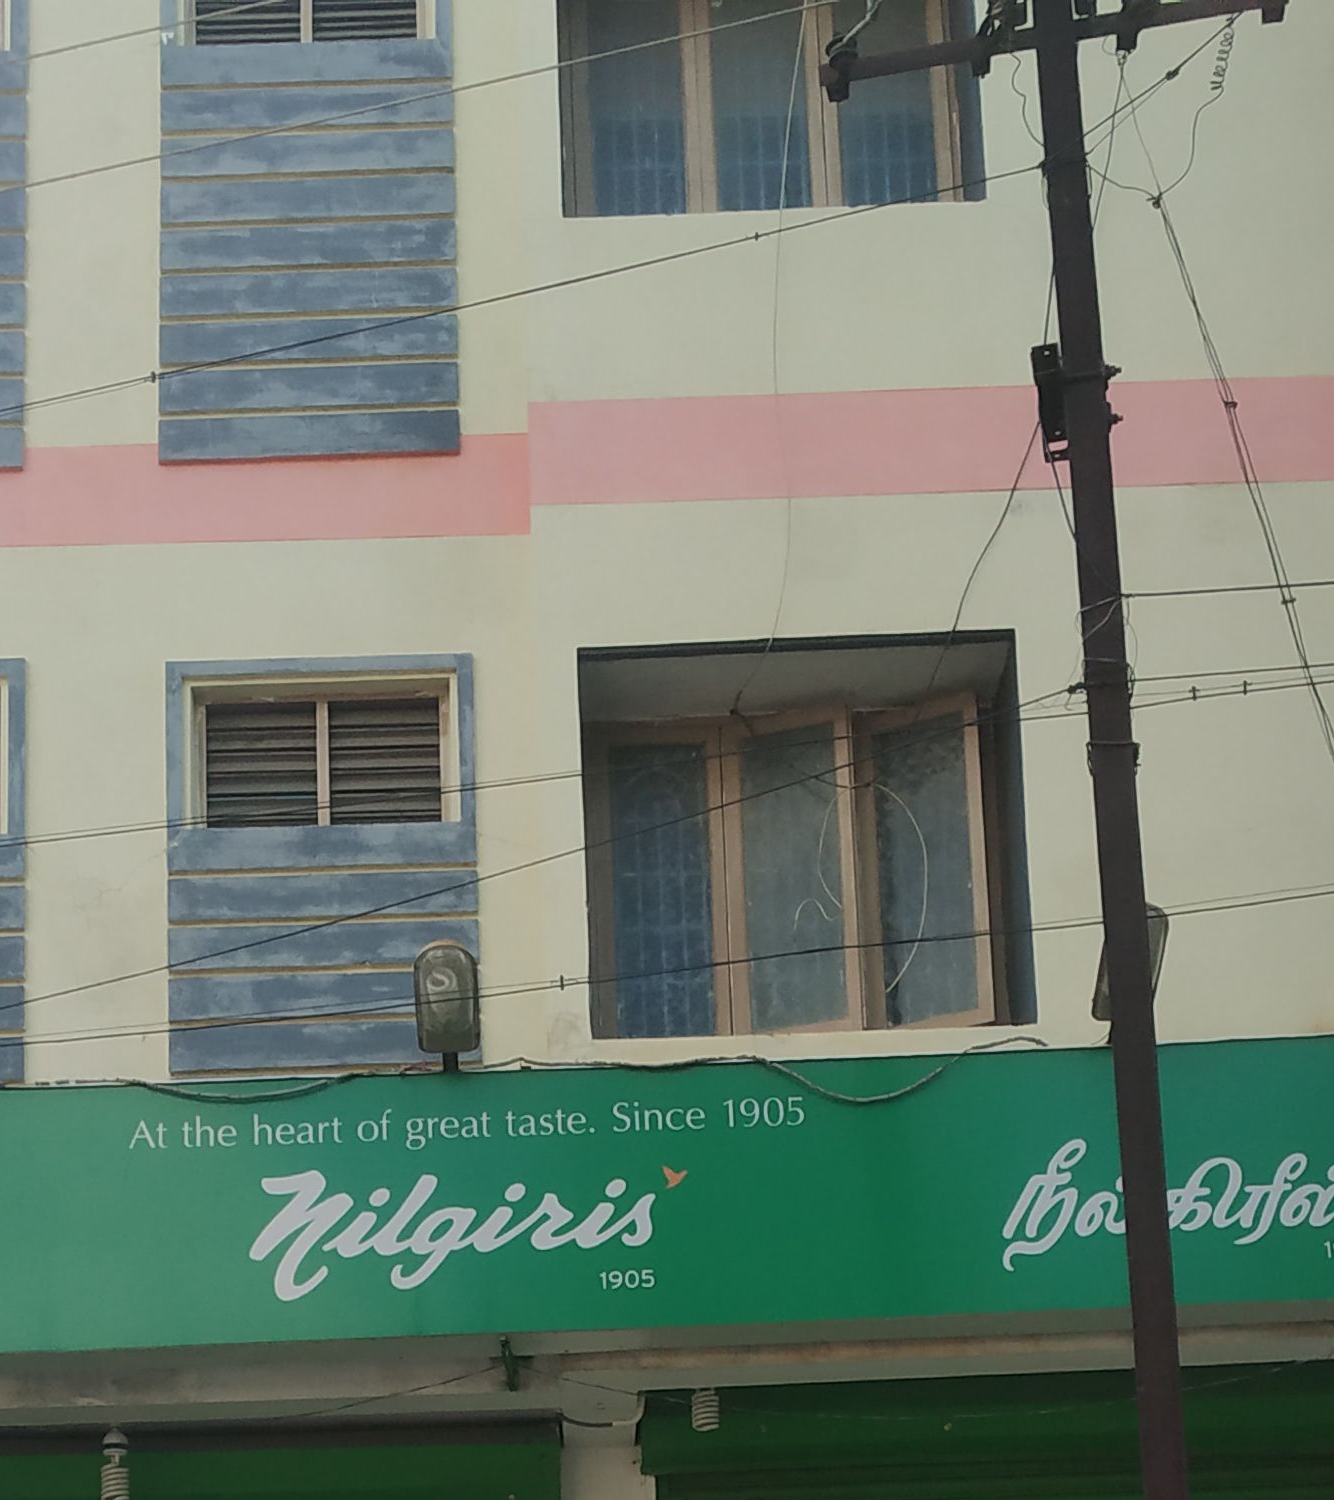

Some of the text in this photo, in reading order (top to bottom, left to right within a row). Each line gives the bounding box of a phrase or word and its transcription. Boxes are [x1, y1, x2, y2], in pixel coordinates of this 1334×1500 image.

[129, 1096, 807, 1150] At the heart of great taste. Since 1905
[248, 1169, 657, 1302] Nilgiris
[599, 1270, 656, 1290] 1905
